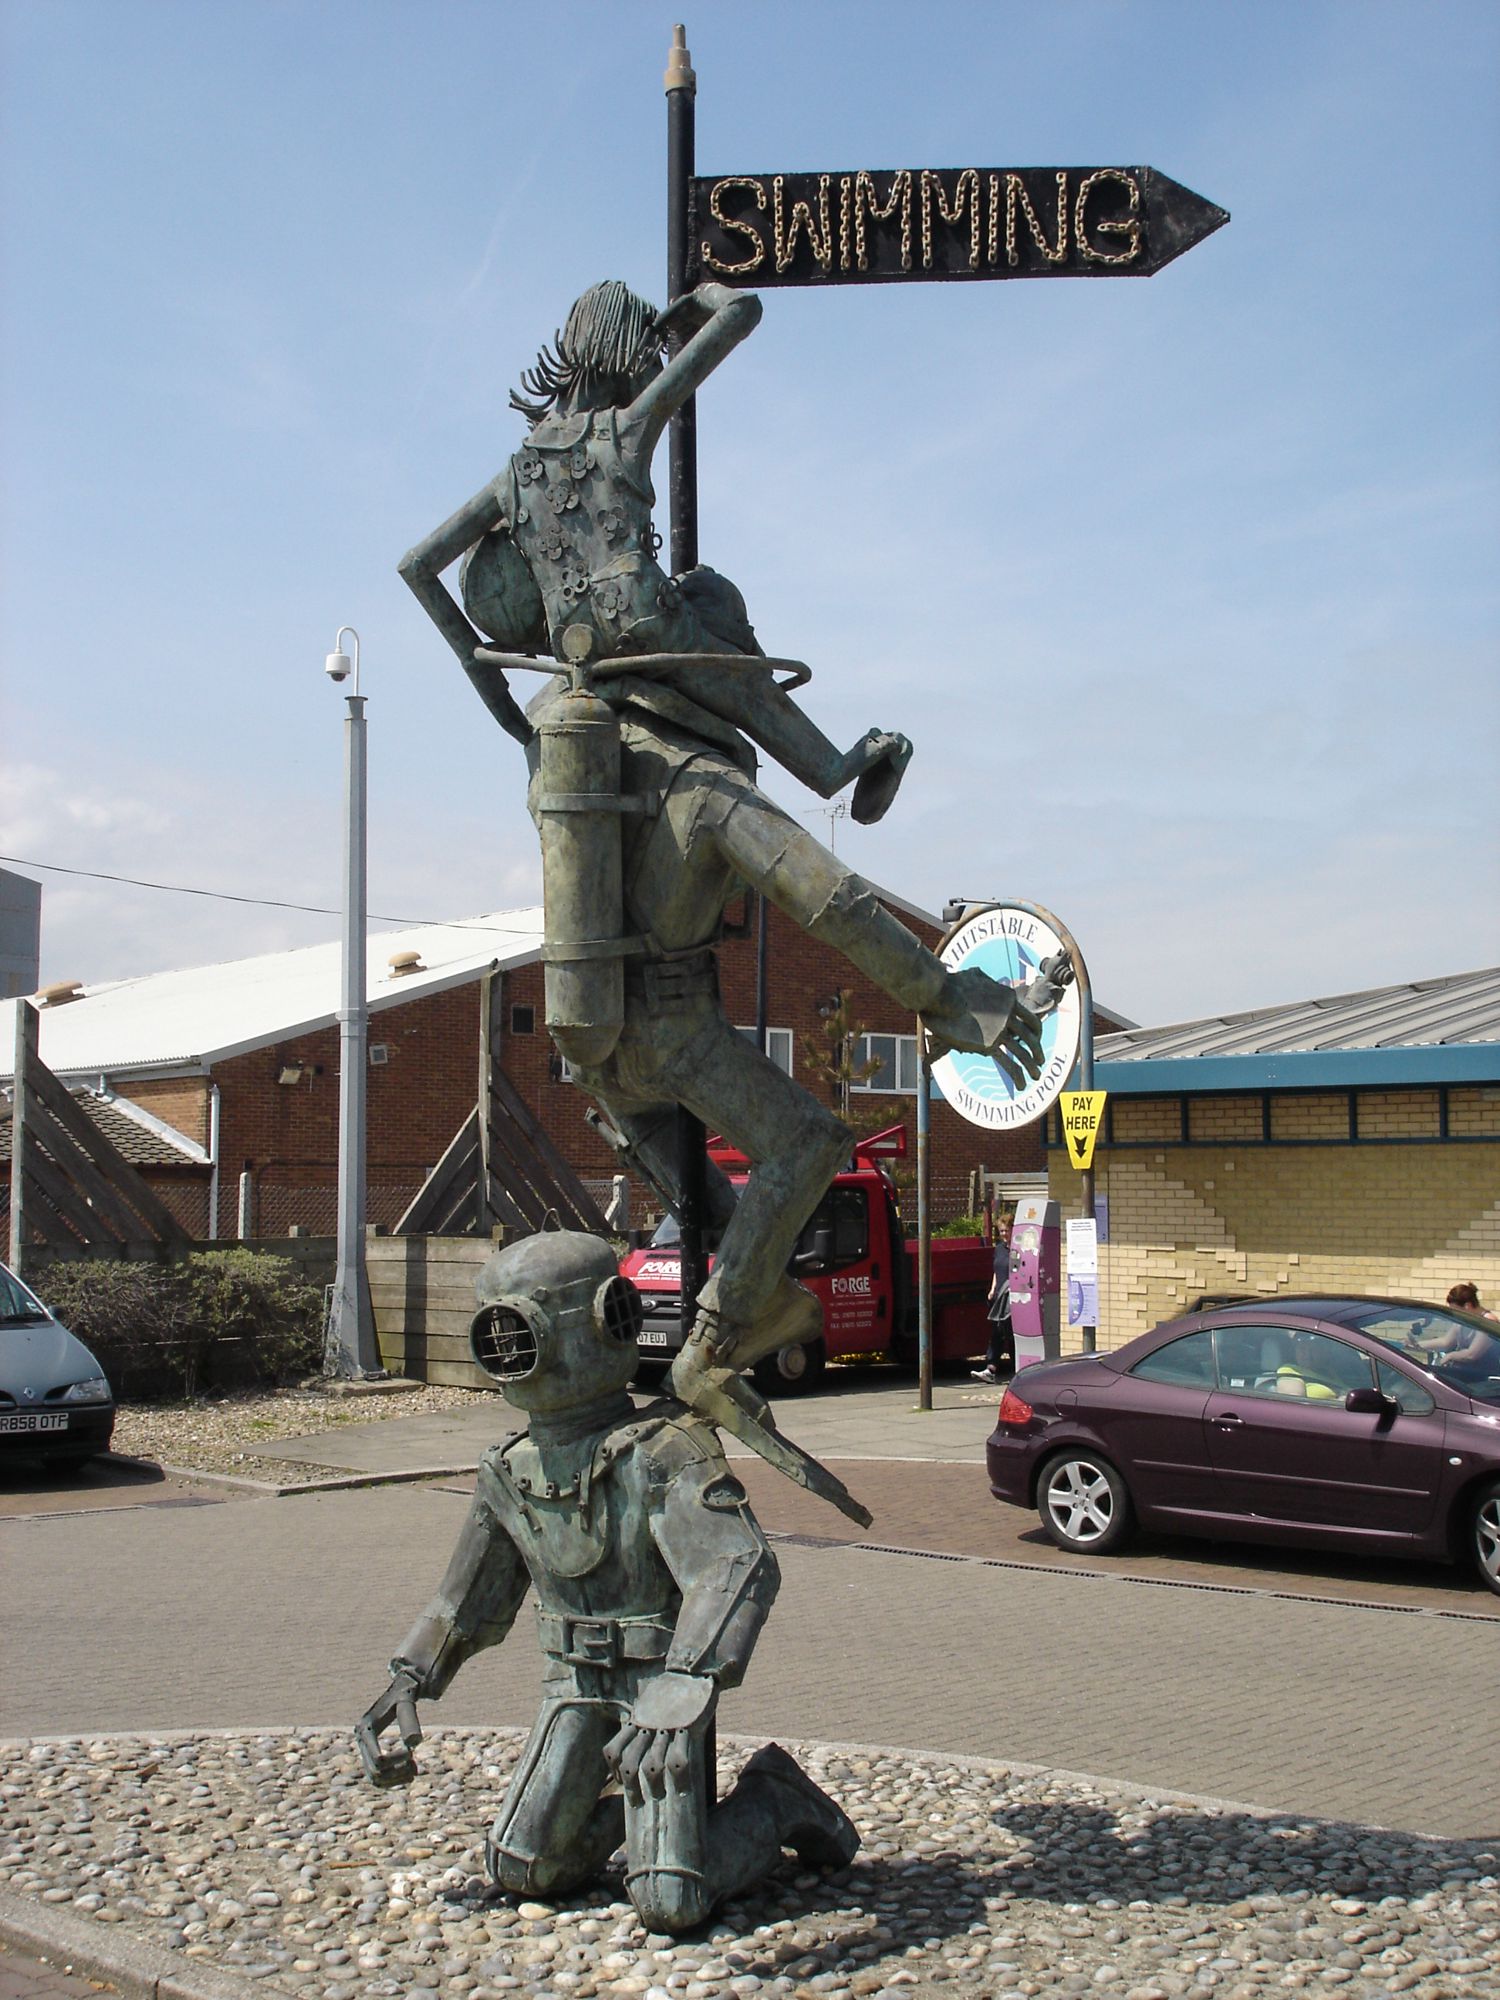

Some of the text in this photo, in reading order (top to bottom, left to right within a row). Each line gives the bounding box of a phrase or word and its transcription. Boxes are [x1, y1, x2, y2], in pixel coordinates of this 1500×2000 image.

[701, 168, 1143, 275] SWIMMING
[954, 1053, 1067, 1123] SWIMMING POOL
[1072, 1097, 1094, 1111] PAY
[1066, 1115, 1096, 1130] HERE
[637, 1261, 682, 1275] FORG
[831, 1276, 871, 1294] FORGE
[0, 1416, 36, 1430] R858
